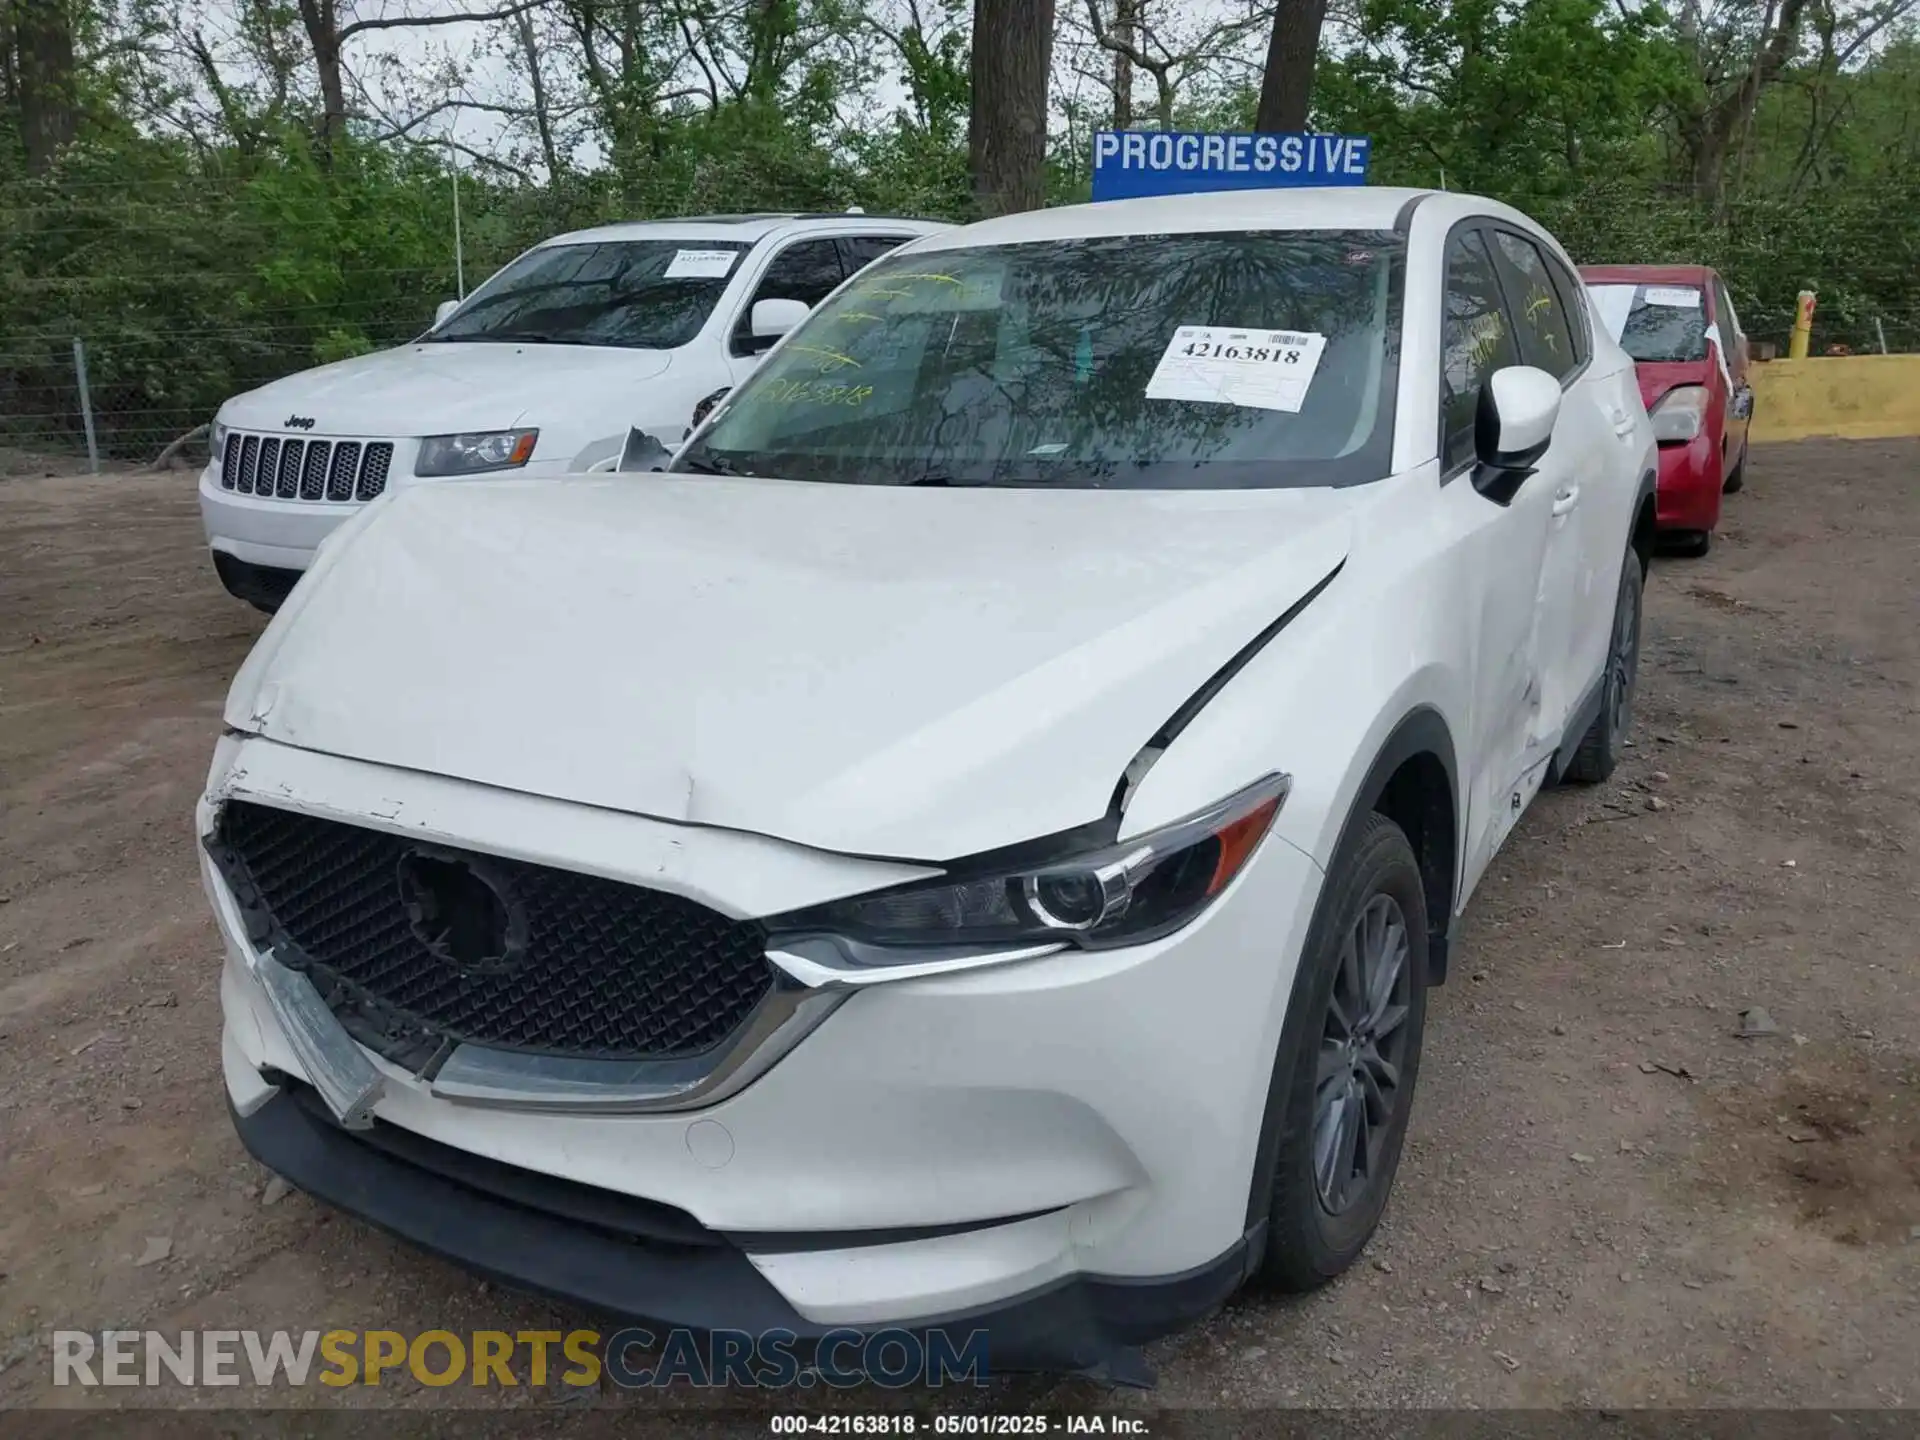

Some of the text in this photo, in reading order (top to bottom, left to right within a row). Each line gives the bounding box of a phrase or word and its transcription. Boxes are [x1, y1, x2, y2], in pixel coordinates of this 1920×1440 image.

[1095, 133, 1367, 174] PROGRESSIVE
[1181, 342, 1301, 365] 42163818
[284, 414, 316, 431] Jeep
